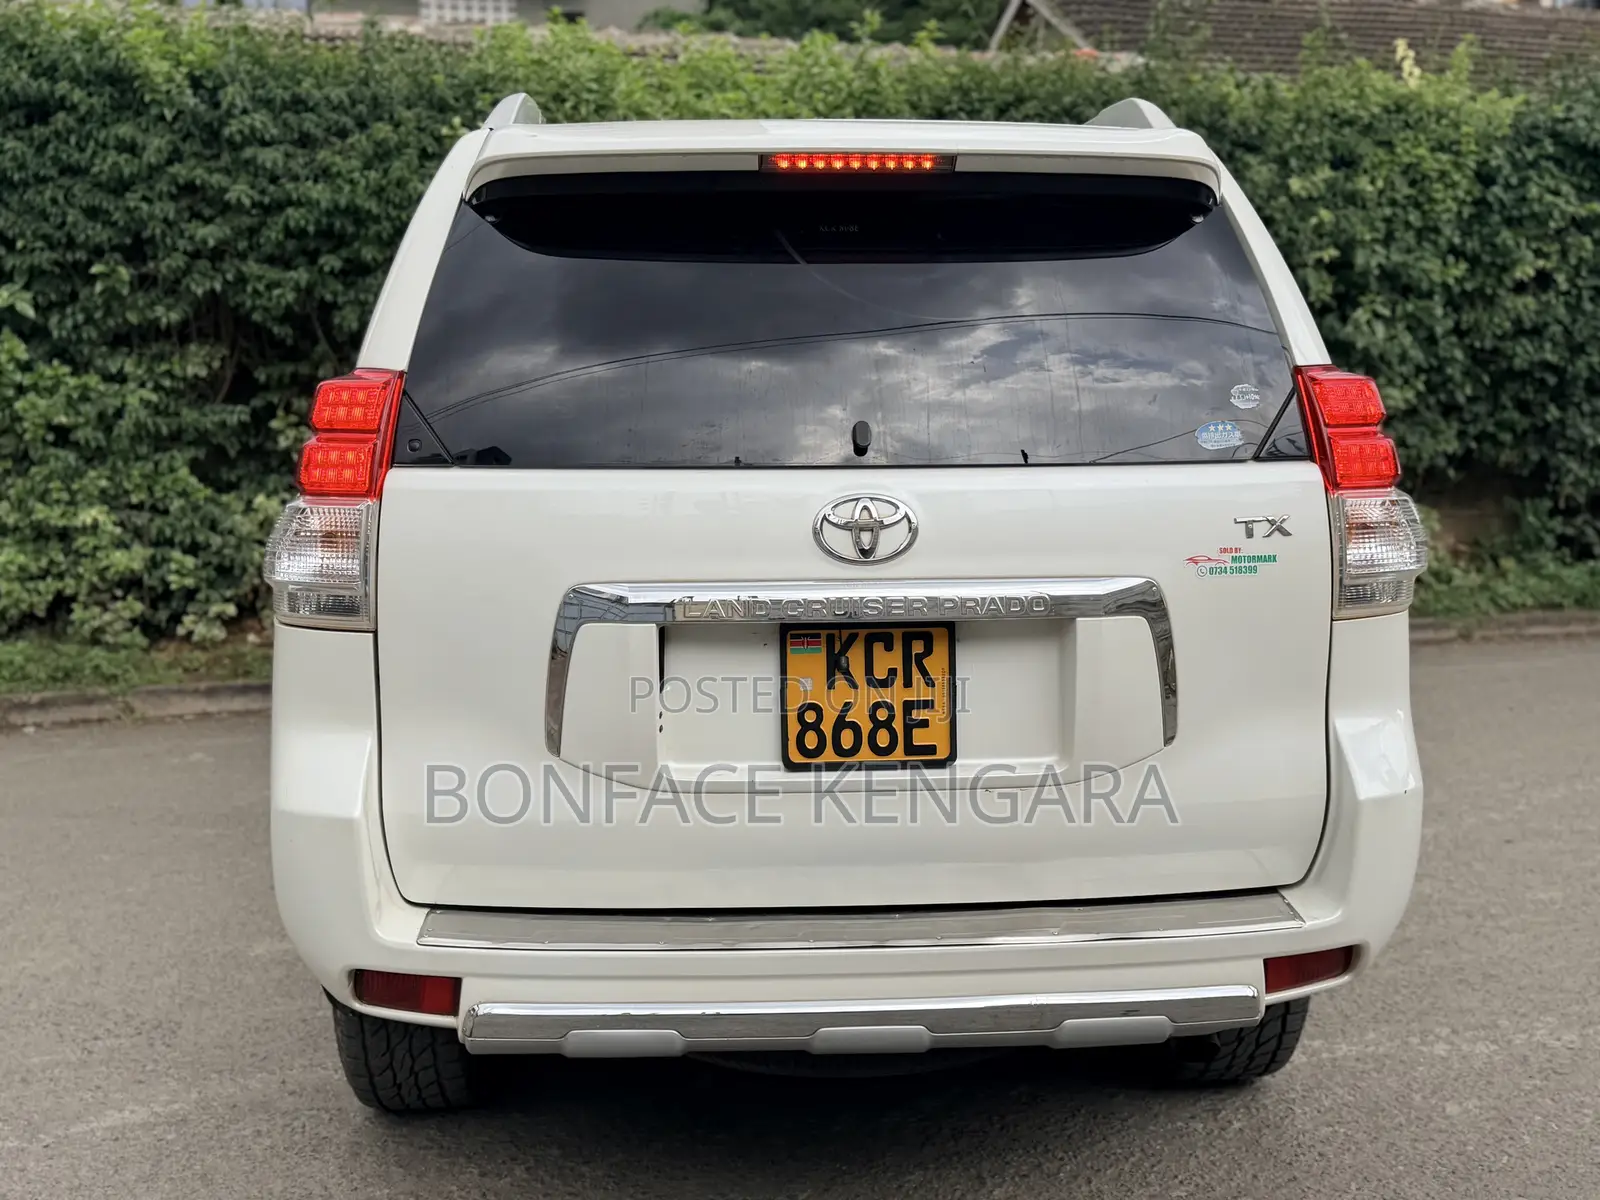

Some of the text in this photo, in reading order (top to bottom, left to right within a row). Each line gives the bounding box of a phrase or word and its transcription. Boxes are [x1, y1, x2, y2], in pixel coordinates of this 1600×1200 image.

[1234, 514, 1292, 539] TX
[1209, 565, 1258, 575] 0734 518399
[1231, 555, 1277, 564] MOTORMARK
[682, 593, 1052, 620] LAND CRUISER PRADO
[826, 631, 936, 690] KCR
[796, 699, 938, 758] 868E
